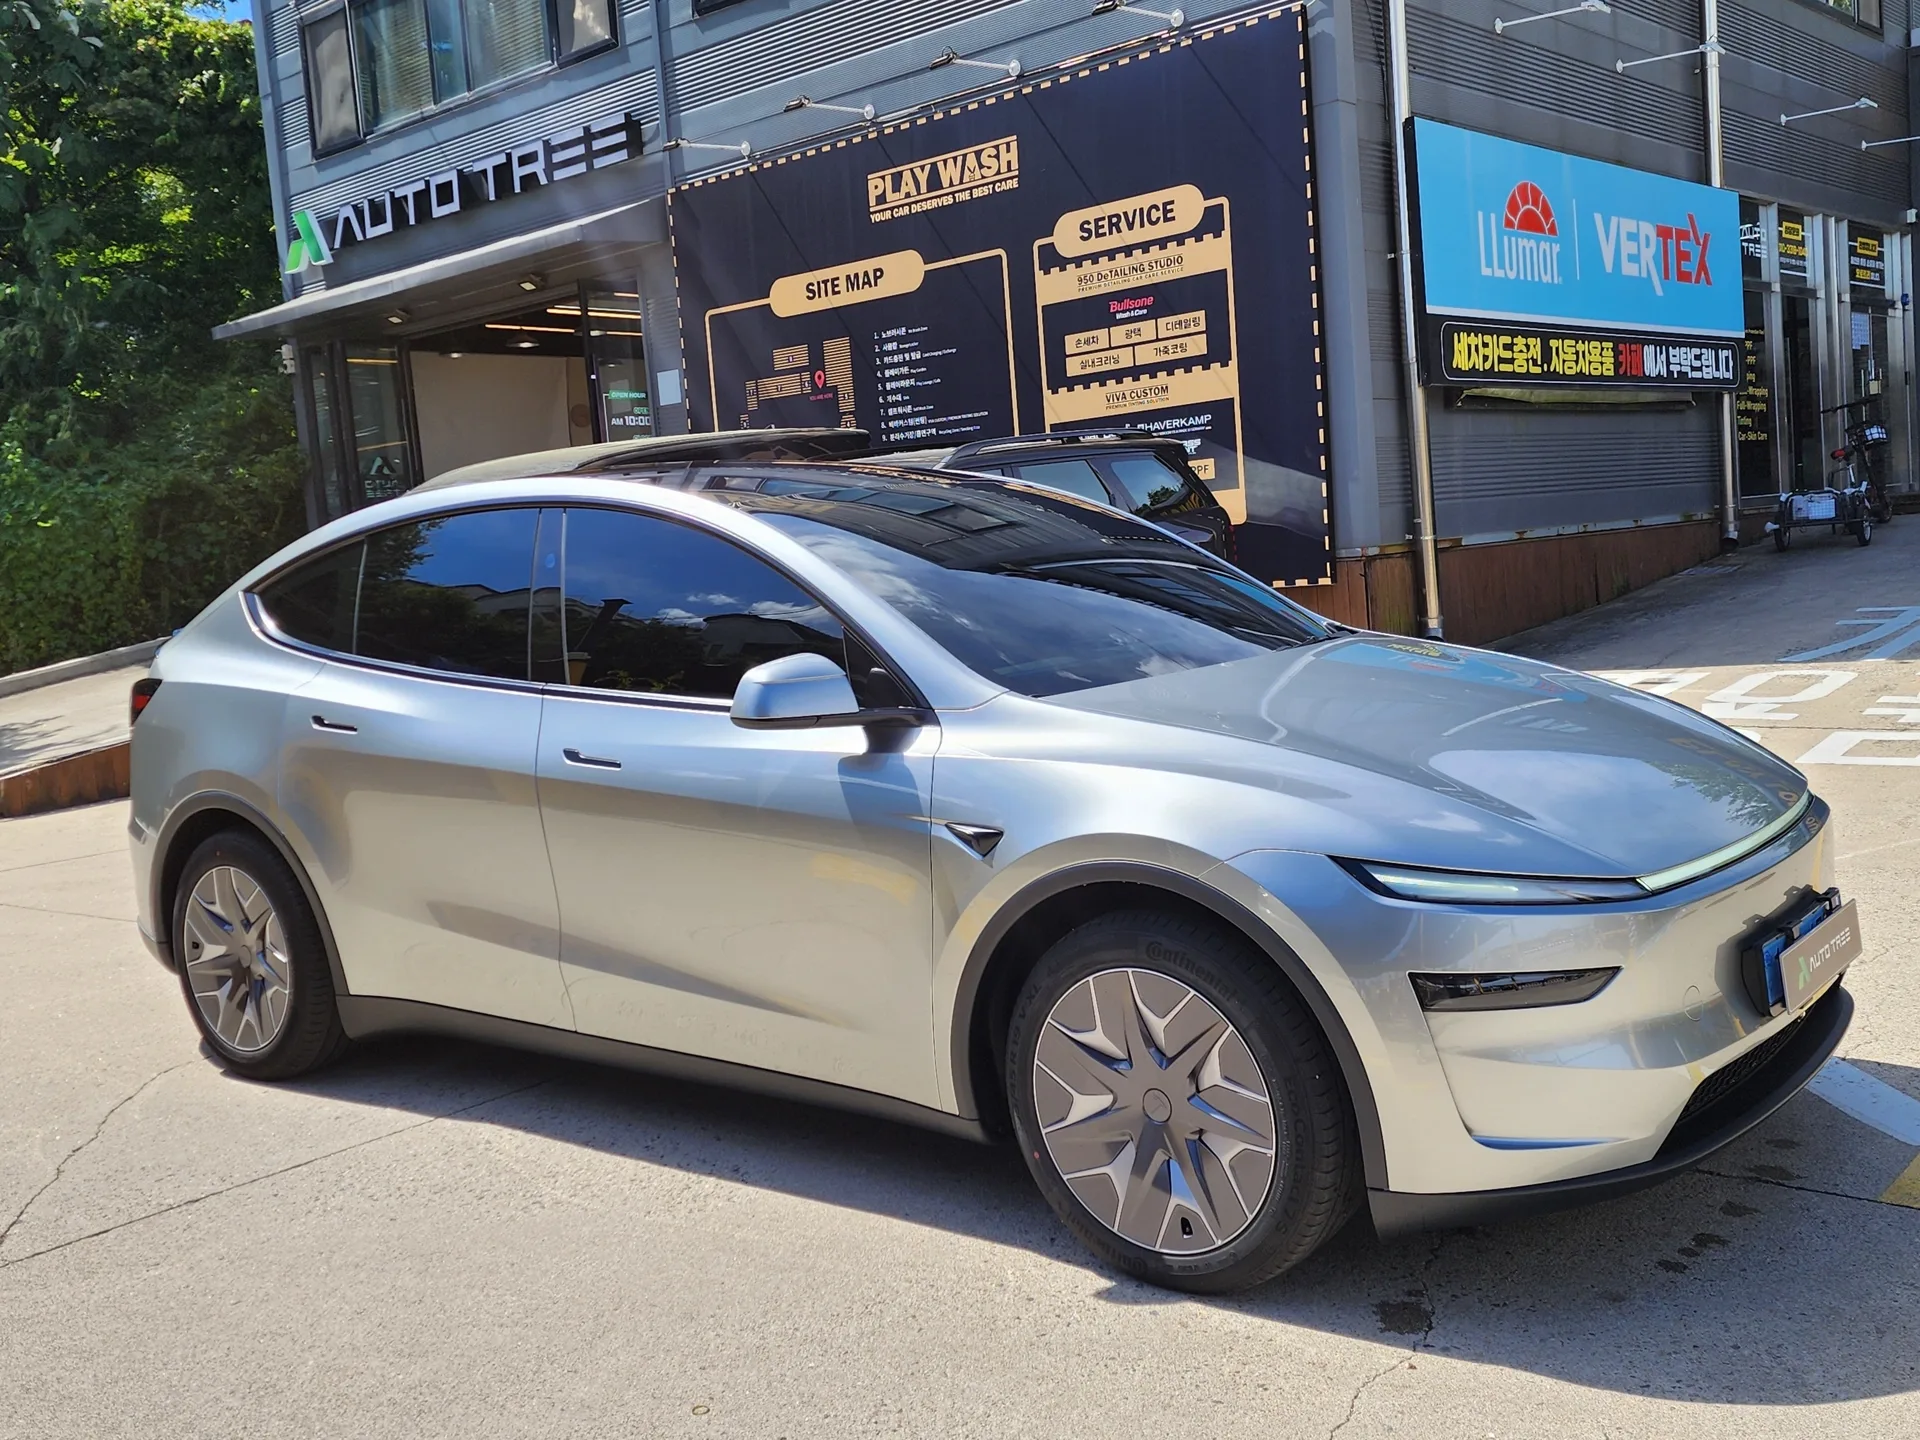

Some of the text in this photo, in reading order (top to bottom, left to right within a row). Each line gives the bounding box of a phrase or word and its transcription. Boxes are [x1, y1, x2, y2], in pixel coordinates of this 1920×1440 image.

[333, 112, 629, 249] AUTO TREE
[868, 140, 1018, 207] PLAY WASH
[870, 177, 1019, 224] YOUR CAR DESERVES THE BEST CARE
[1079, 200, 1176, 242] SERVICE
[1741, 225, 1767, 242] AUTO
[1477, 210, 1713, 297] LLumar VERTEX
[1741, 241, 1768, 259] TREE
[805, 267, 885, 301] SITE MAP
[1077, 255, 1184, 286] 950 DeTAILING STUDIO
[1077, 283, 1103, 293] PREMIUM
[1103, 278, 1131, 288] DETAILING
[1144, 272, 1159, 280] CARE
[1160, 266, 1184, 276] SERVICE
[1109, 296, 1154, 313] Bullsone
[1115, 310, 1131, 320] Wash
[1134, 308, 1148, 317] Care
[1075, 316, 1201, 349] 손세차 광택 디테일링
[1079, 354, 1120, 371] 실내크리닝
[1668, 345, 1734, 380] 부탁드립니다
[611, 391, 629, 399] OPEN
[1105, 385, 1169, 403] VIVA CUSTOM
[611, 417, 624, 426] AM
[1145, 414, 1212, 432] HAVERKAMP
[1809, 943, 1831, 973] AUTO
[1830, 926, 1851, 953] TREE
[1144, 940, 1238, 1003] Continental
